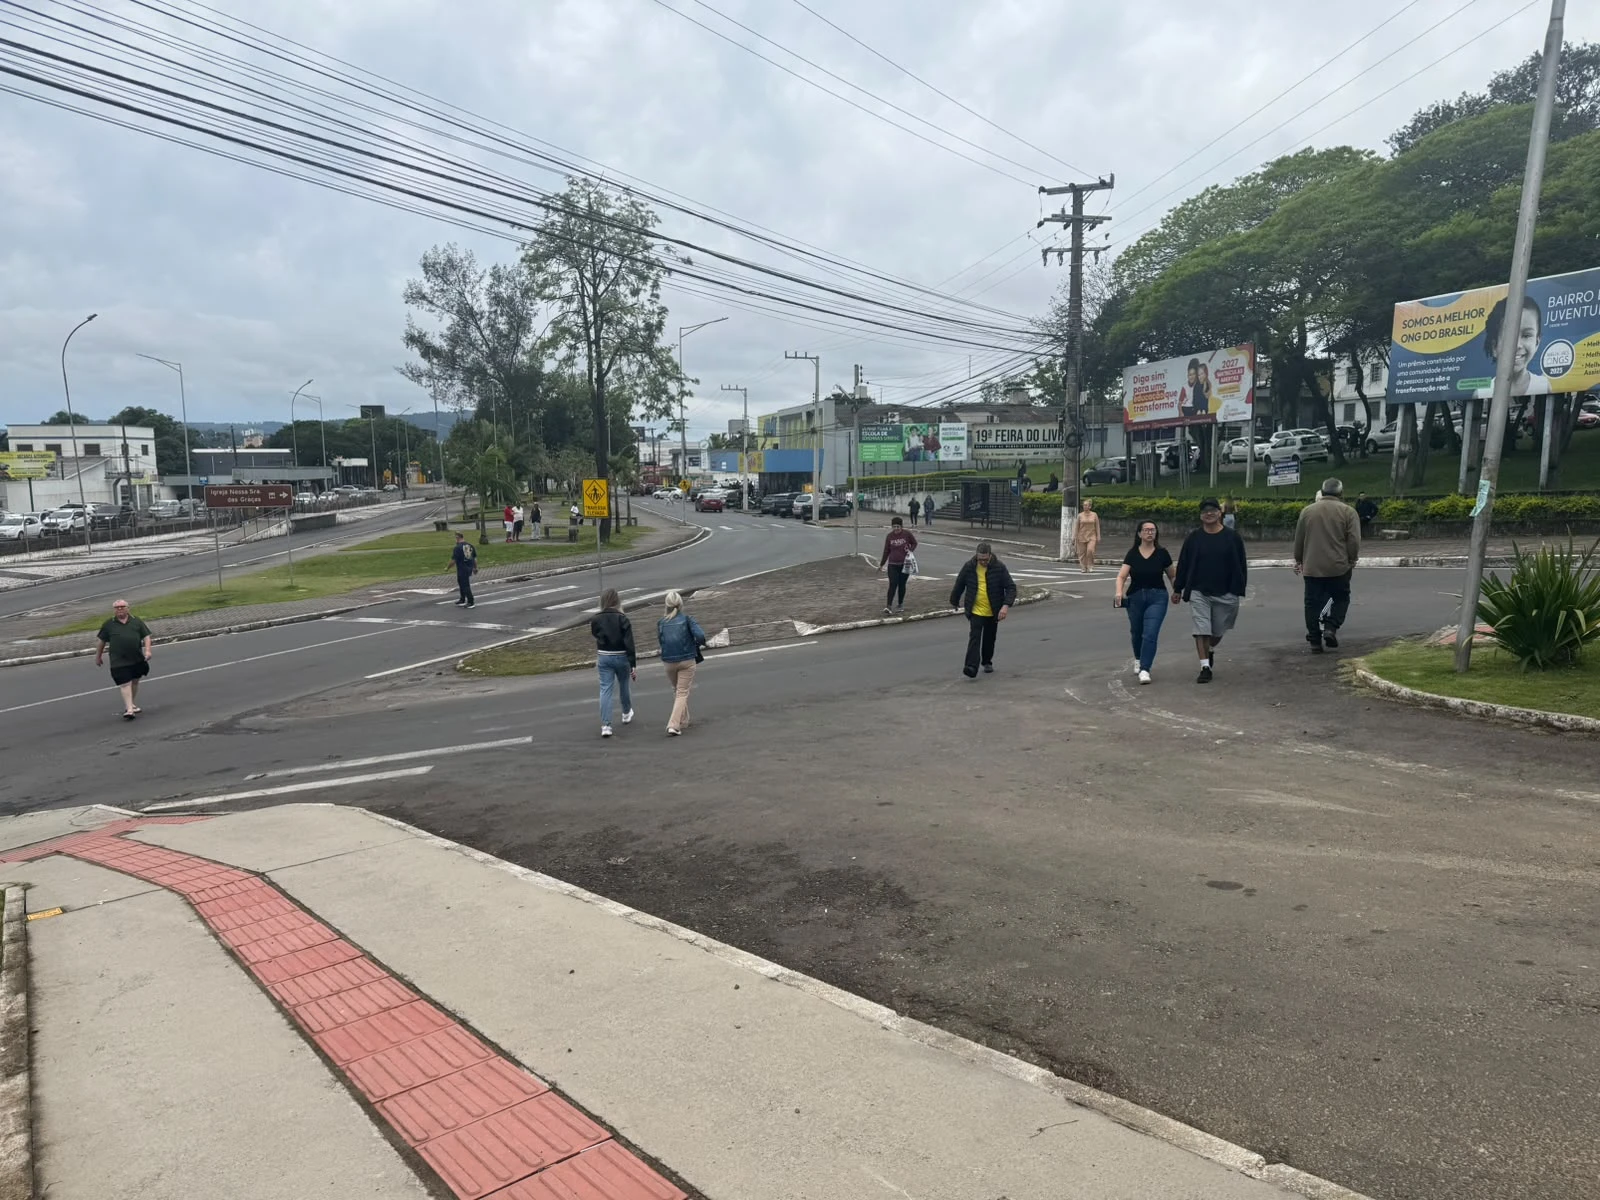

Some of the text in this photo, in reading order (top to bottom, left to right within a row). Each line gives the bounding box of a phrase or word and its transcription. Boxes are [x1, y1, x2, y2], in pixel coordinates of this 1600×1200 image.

[1548, 290, 1594, 308] BAIRRO
[1402, 307, 1485, 329] SOMOS A MELHOR
[1543, 304, 1600, 326] JUVENTU
[1401, 324, 1474, 344] ONG DO BRASIL!
[1221, 358, 1239, 369] 2027
[1455, 355, 1466, 363] por
[1546, 355, 1569, 365] ONGS
[1408, 366, 1441, 376] comunidade
[1550, 367, 1563, 375] 2025
[1133, 374, 1149, 385] Diga
[1403, 378, 1424, 386] pessoas
[1133, 382, 1167, 395] para uma
[1164, 390, 1178, 400] que
[1133, 401, 1175, 412] transforma
[975, 428, 1064, 442] 19ª FEIRA DO LIVR
[210, 488, 228, 496] Igreja
